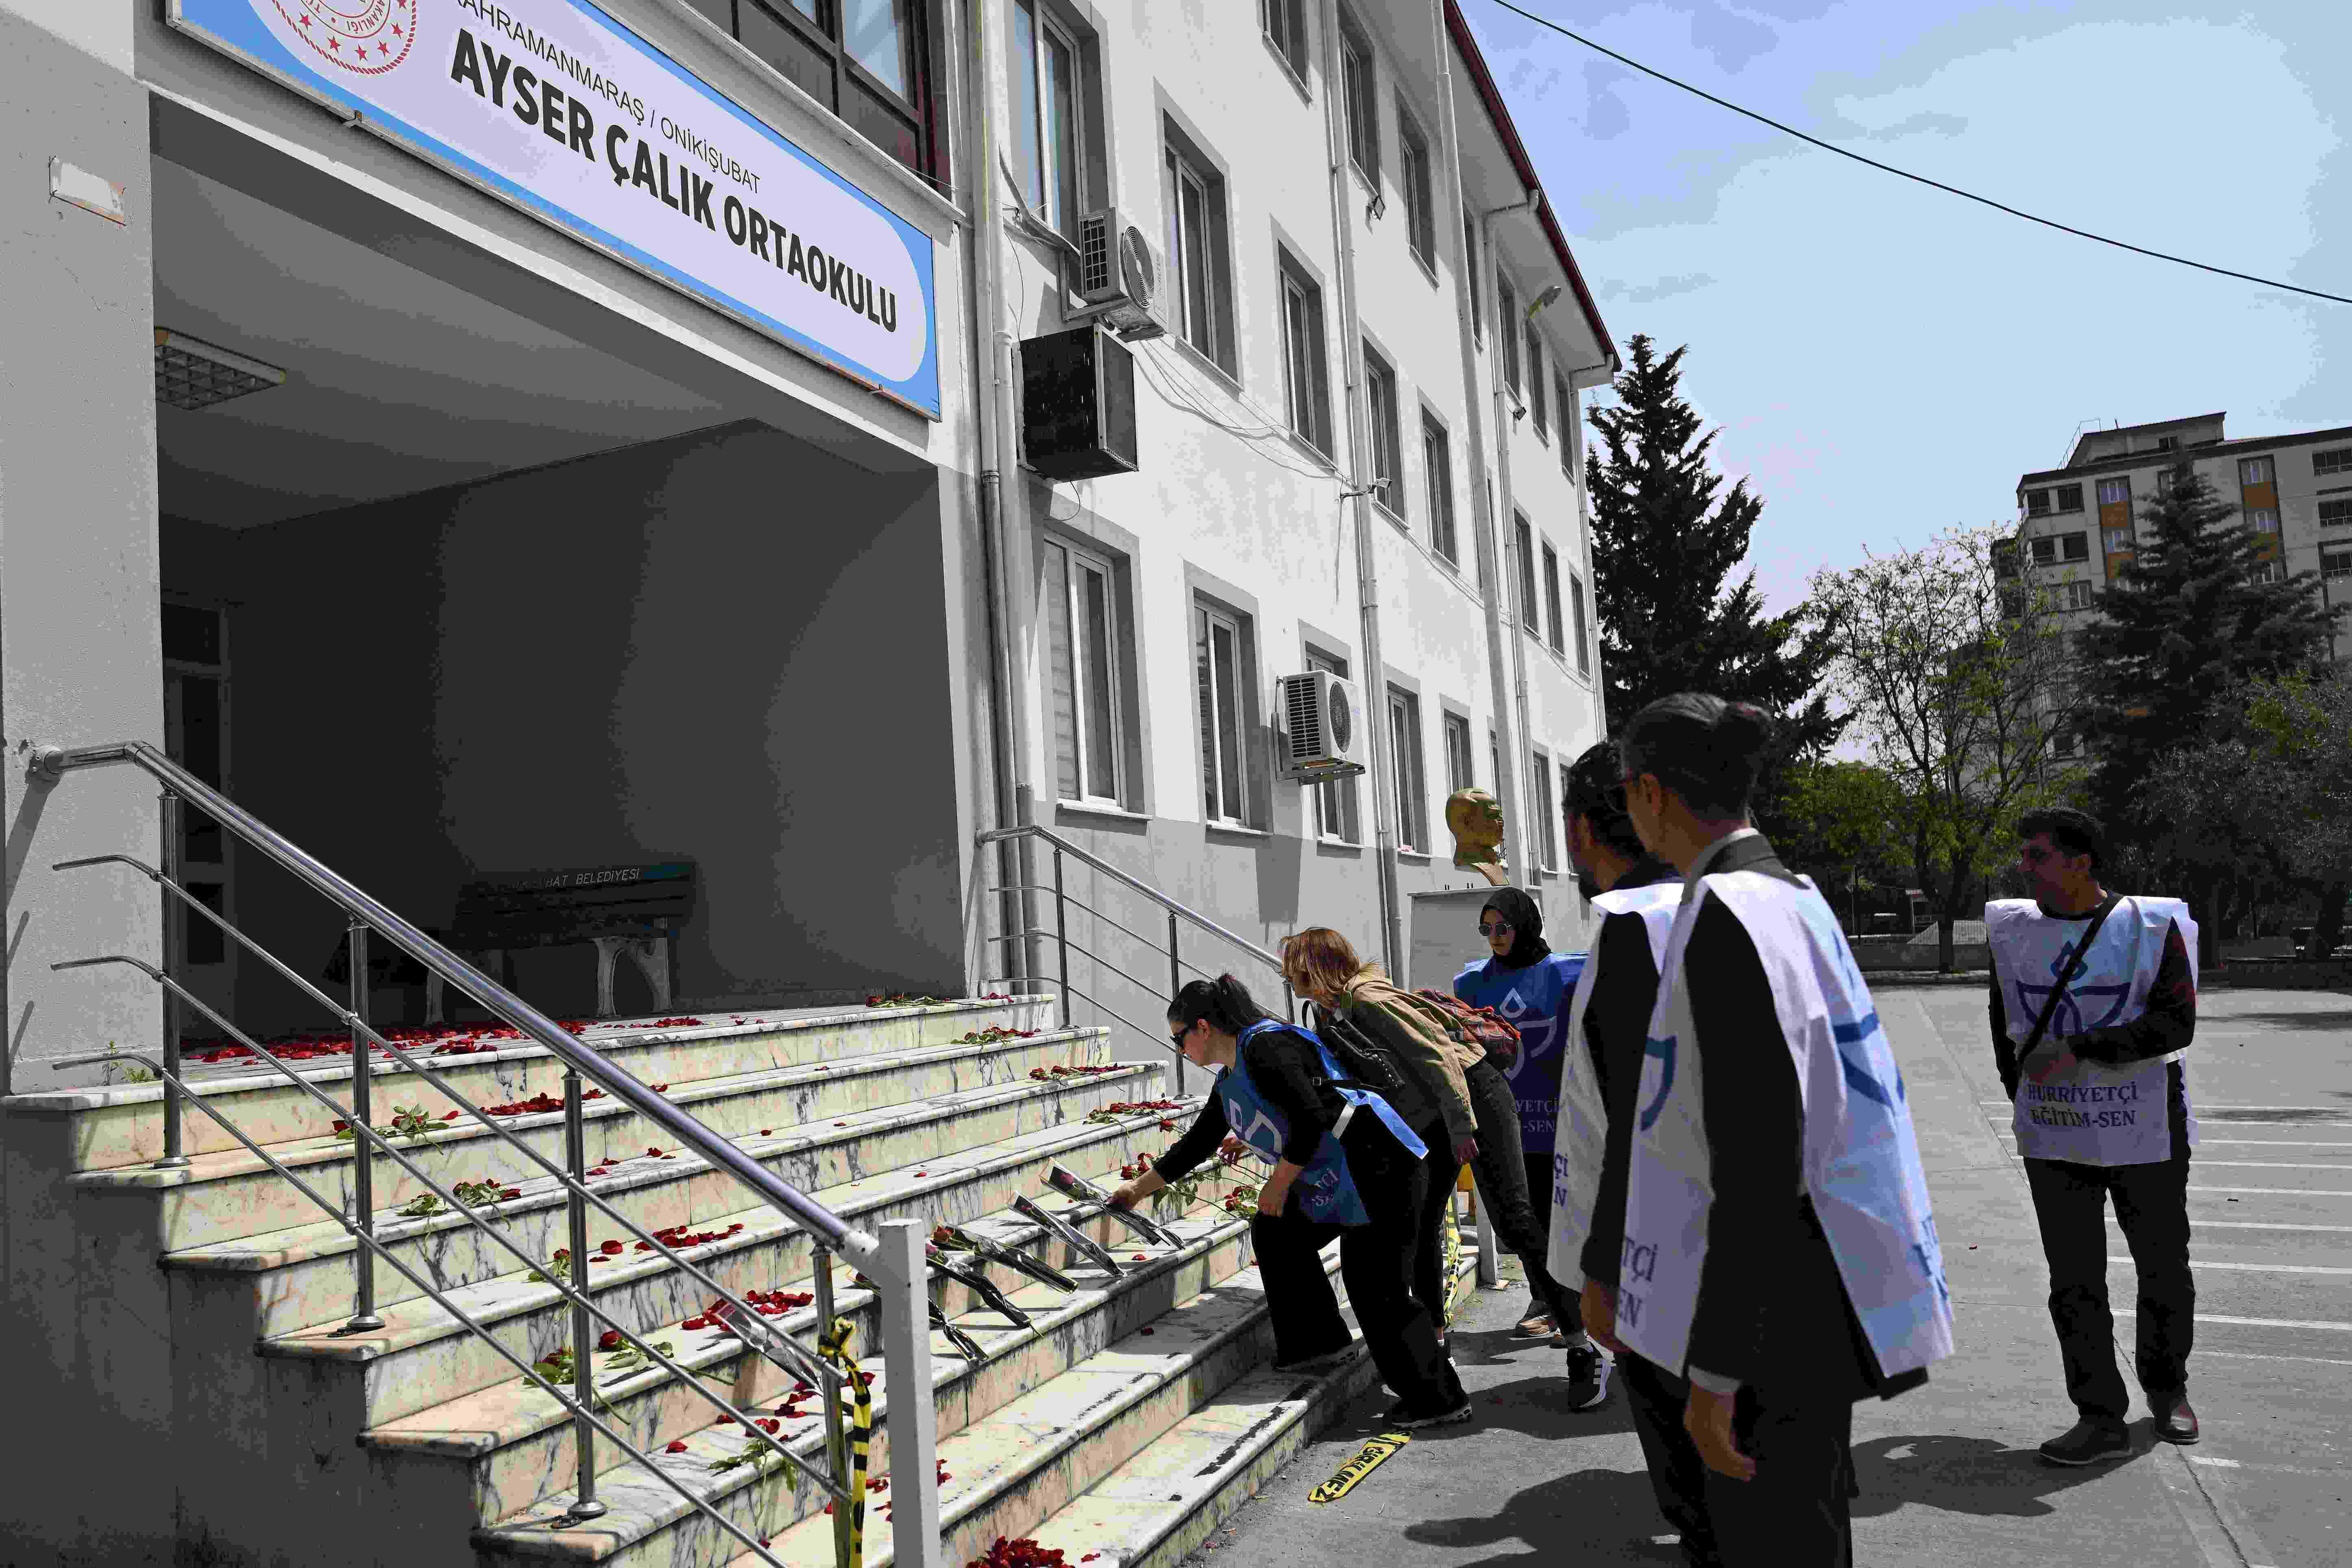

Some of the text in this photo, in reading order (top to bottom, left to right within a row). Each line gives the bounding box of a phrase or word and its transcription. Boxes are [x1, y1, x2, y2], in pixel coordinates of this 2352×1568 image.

[347, 0, 385, 33] AKANLIĞI
[458, 0, 760, 194] AHRAMANMARAŞ / ONİKİŞUBAT
[451, 28, 896, 333] AYSER ÇALIK ORTAOKULU
[576, 868, 641, 885] BELEDİYESİ
[2029, 1105, 2137, 1128] EĞİTİM-SEN
